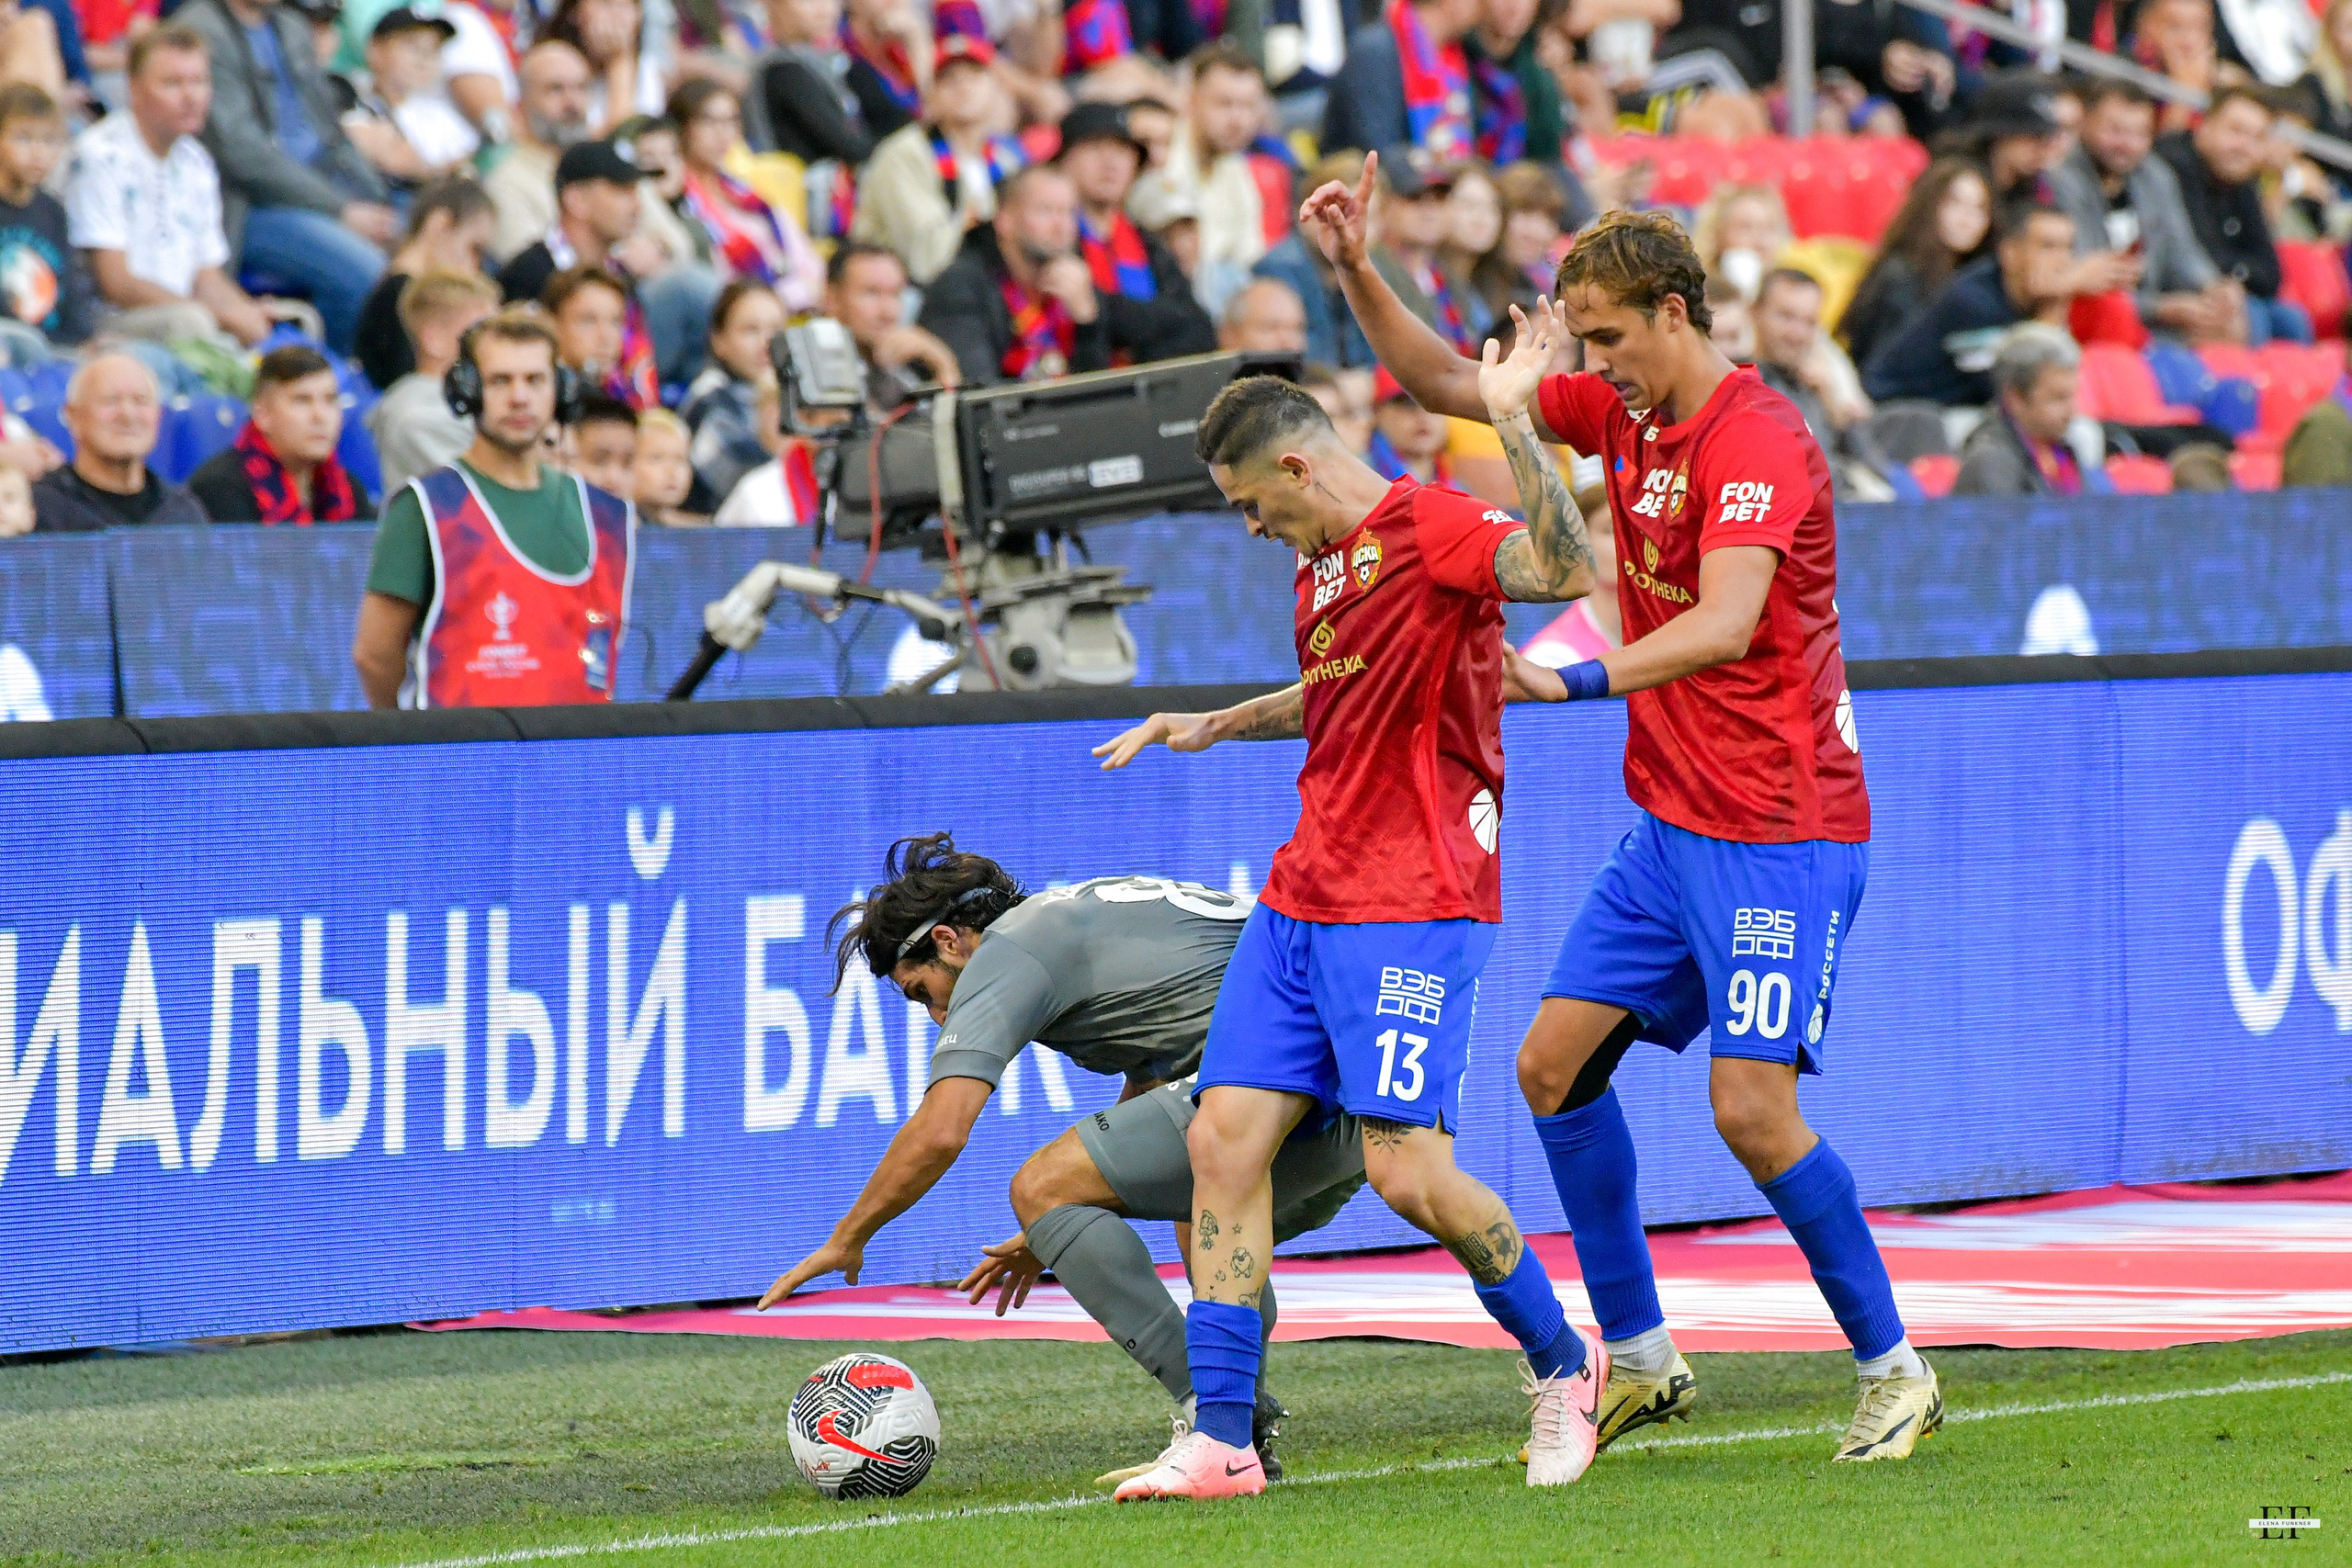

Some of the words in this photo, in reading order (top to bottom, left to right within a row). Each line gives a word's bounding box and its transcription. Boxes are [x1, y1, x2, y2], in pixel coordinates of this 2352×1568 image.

[1630, 491, 1667, 519] BE
[1719, 481, 1774, 504] FON
[1718, 502, 1772, 524] BET
[1312, 549, 1344, 587] FON
[1352, 545, 1380, 569] ЦСКА
[1312, 574, 1347, 613] BET
[1734, 908, 1796, 933] ВЭБ
[1732, 935, 1795, 960] РФ
[1817, 909, 1840, 1000] РОССЕТИ
[0, 804, 688, 1185] ИАЛЬНЫЙ
[1380, 966, 1446, 999] ВЭБ
[1375, 994, 1442, 1026] РФ
[1725, 969, 1792, 1040] 90
[1375, 1028, 1430, 1101] 13
